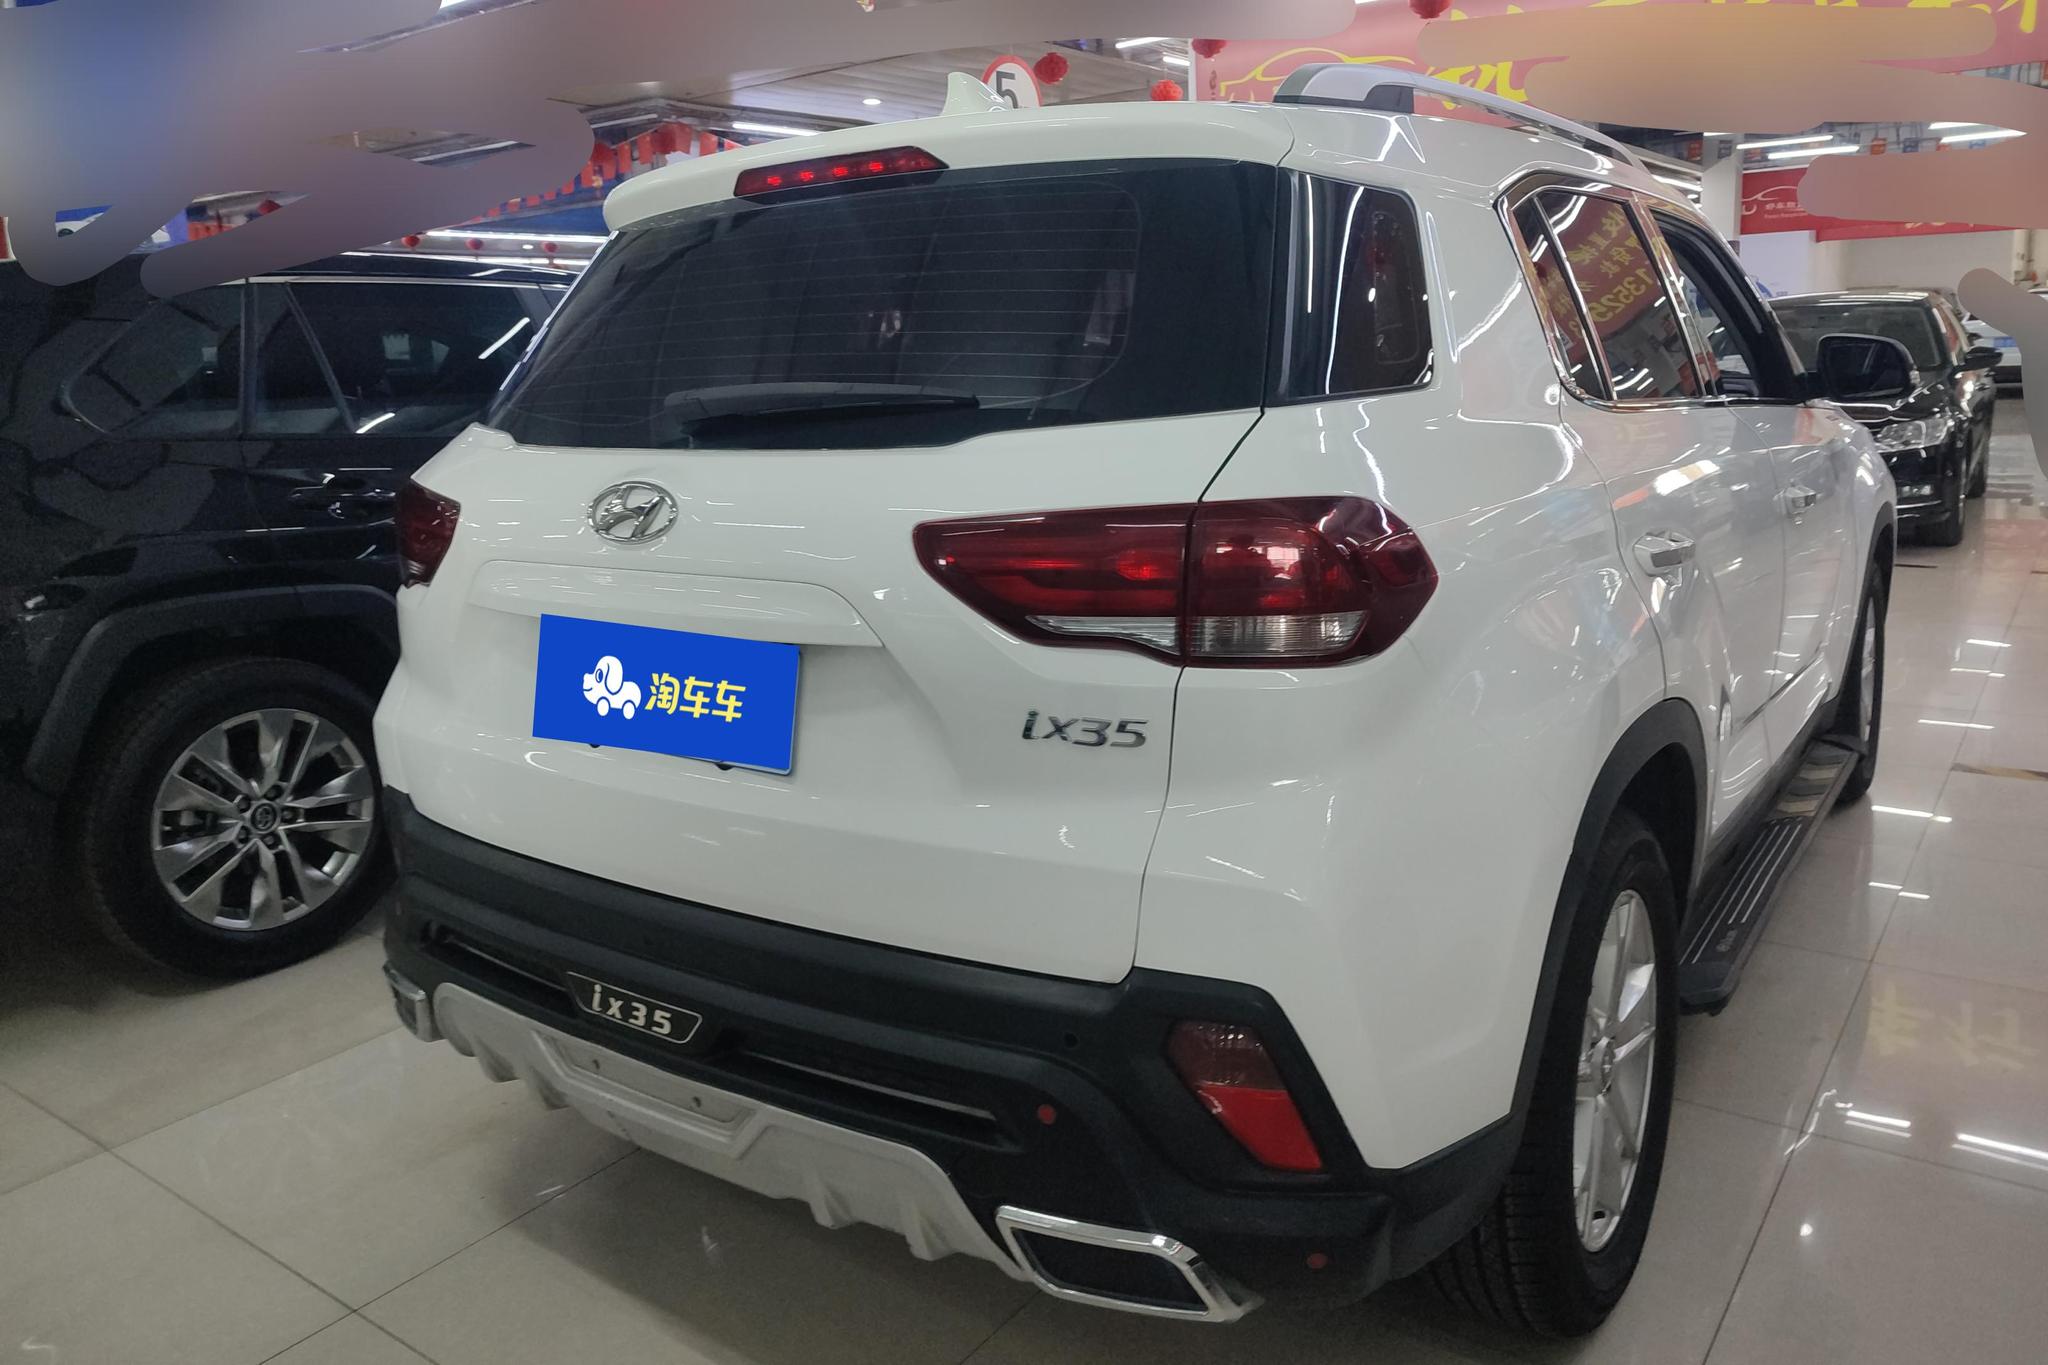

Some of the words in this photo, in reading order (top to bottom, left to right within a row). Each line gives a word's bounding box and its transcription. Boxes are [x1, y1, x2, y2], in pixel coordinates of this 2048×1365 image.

[996, 70, 1018, 109] 5
[1022, 710, 1148, 748] ix35
[592, 984, 672, 1035] ix35
